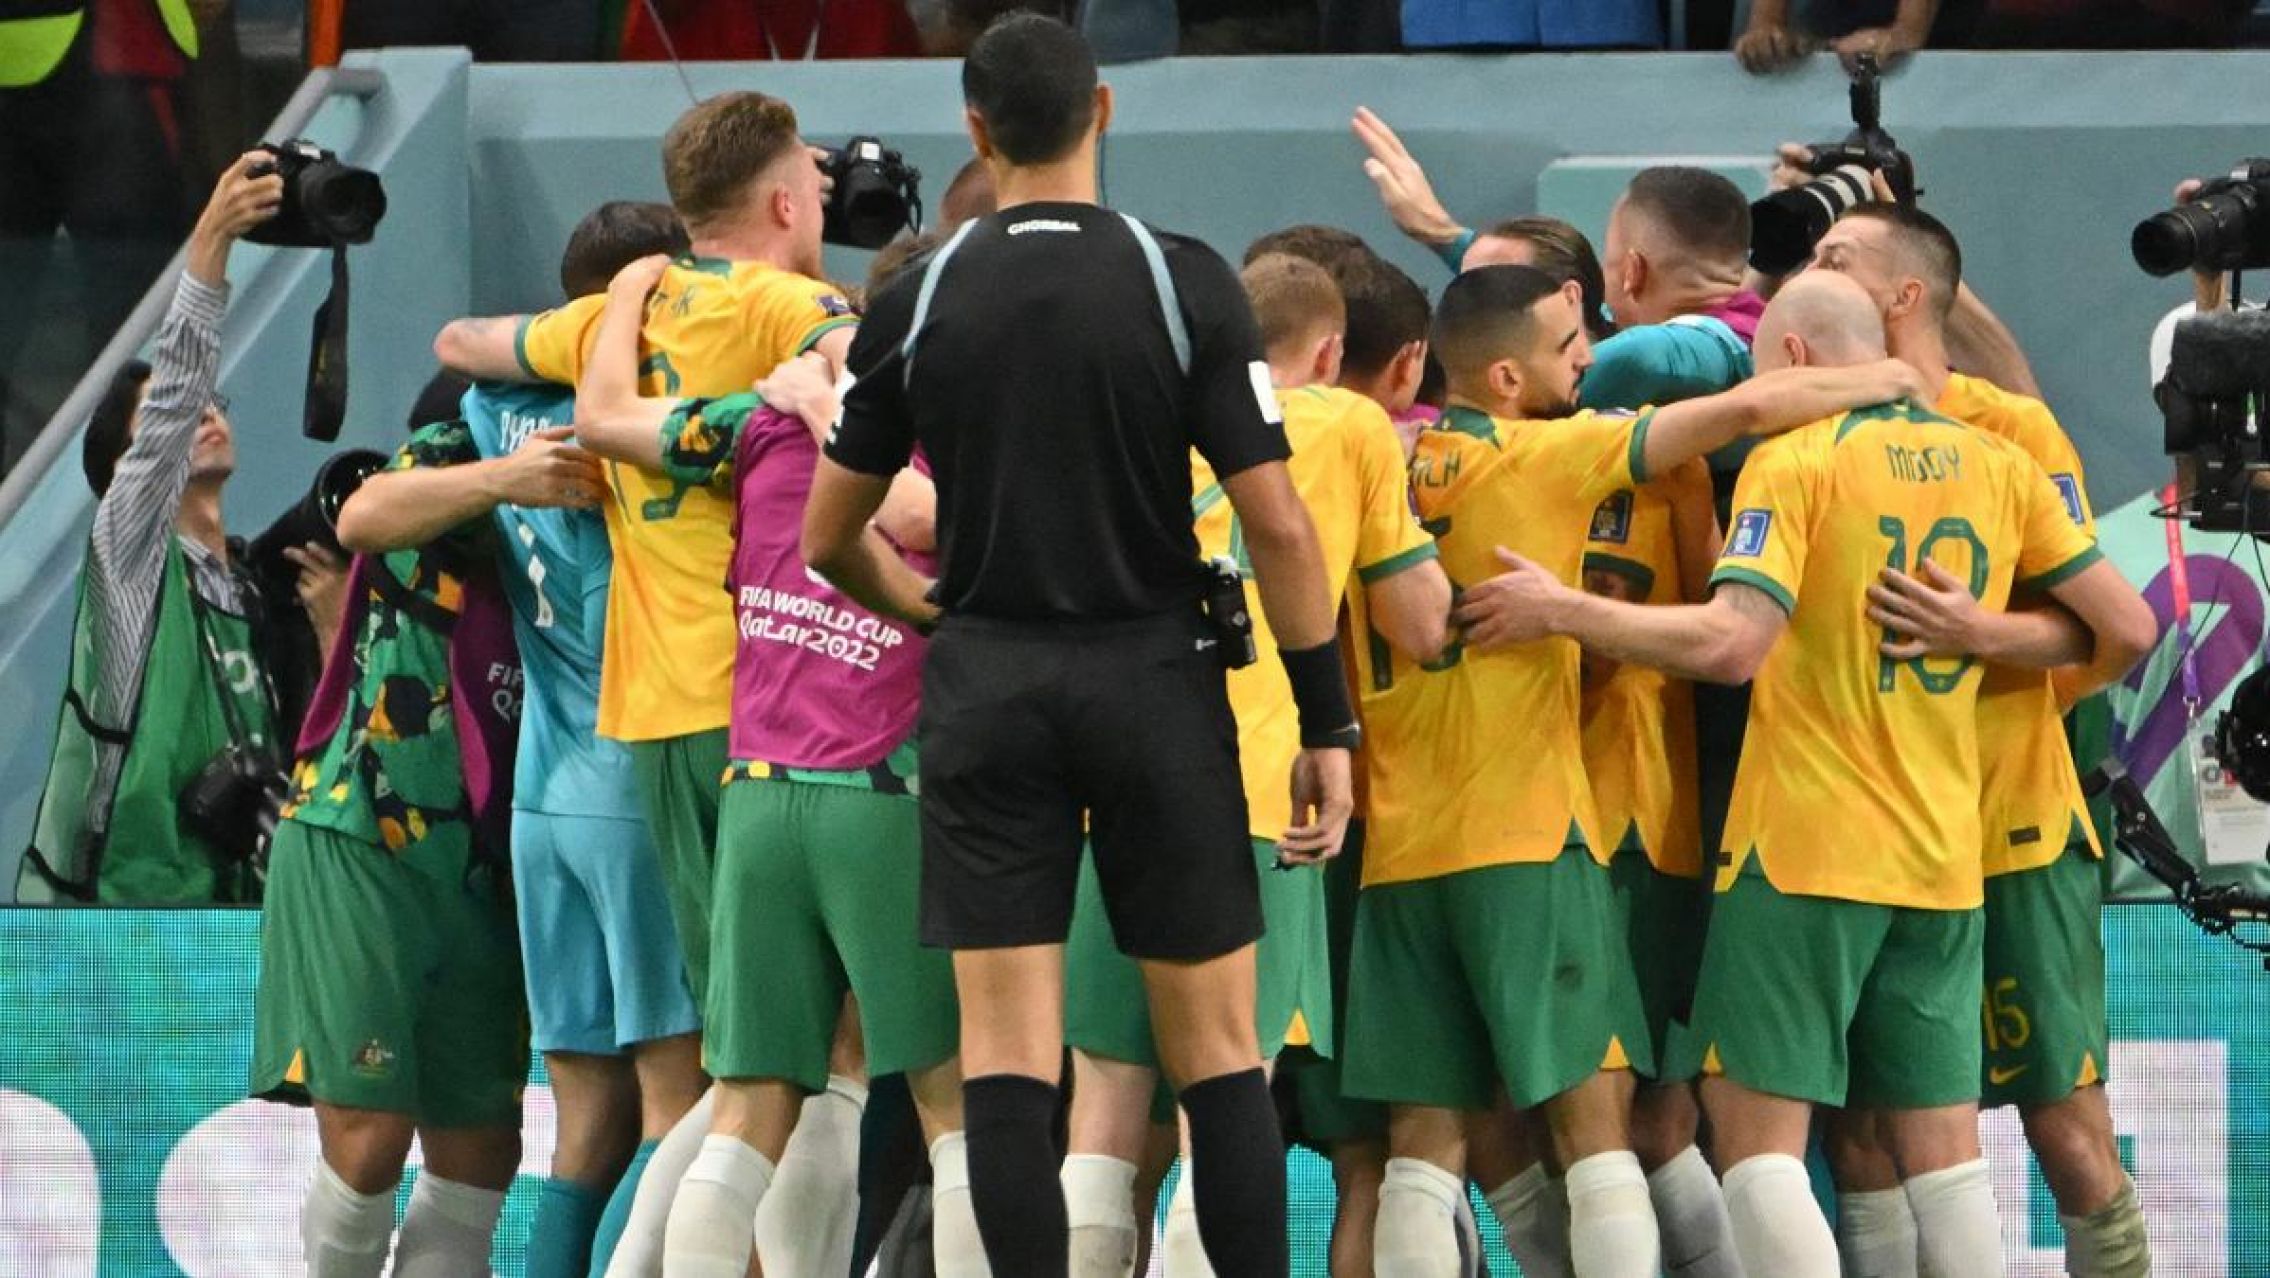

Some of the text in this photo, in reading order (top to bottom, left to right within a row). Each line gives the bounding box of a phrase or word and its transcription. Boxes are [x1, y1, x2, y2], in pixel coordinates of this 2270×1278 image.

[739, 609, 881, 671] Qatar2022
[740, 586, 903, 649] FIFA WORLD CUP
[487, 662, 523, 687] FIF
[1982, 978, 2031, 1052] 15
